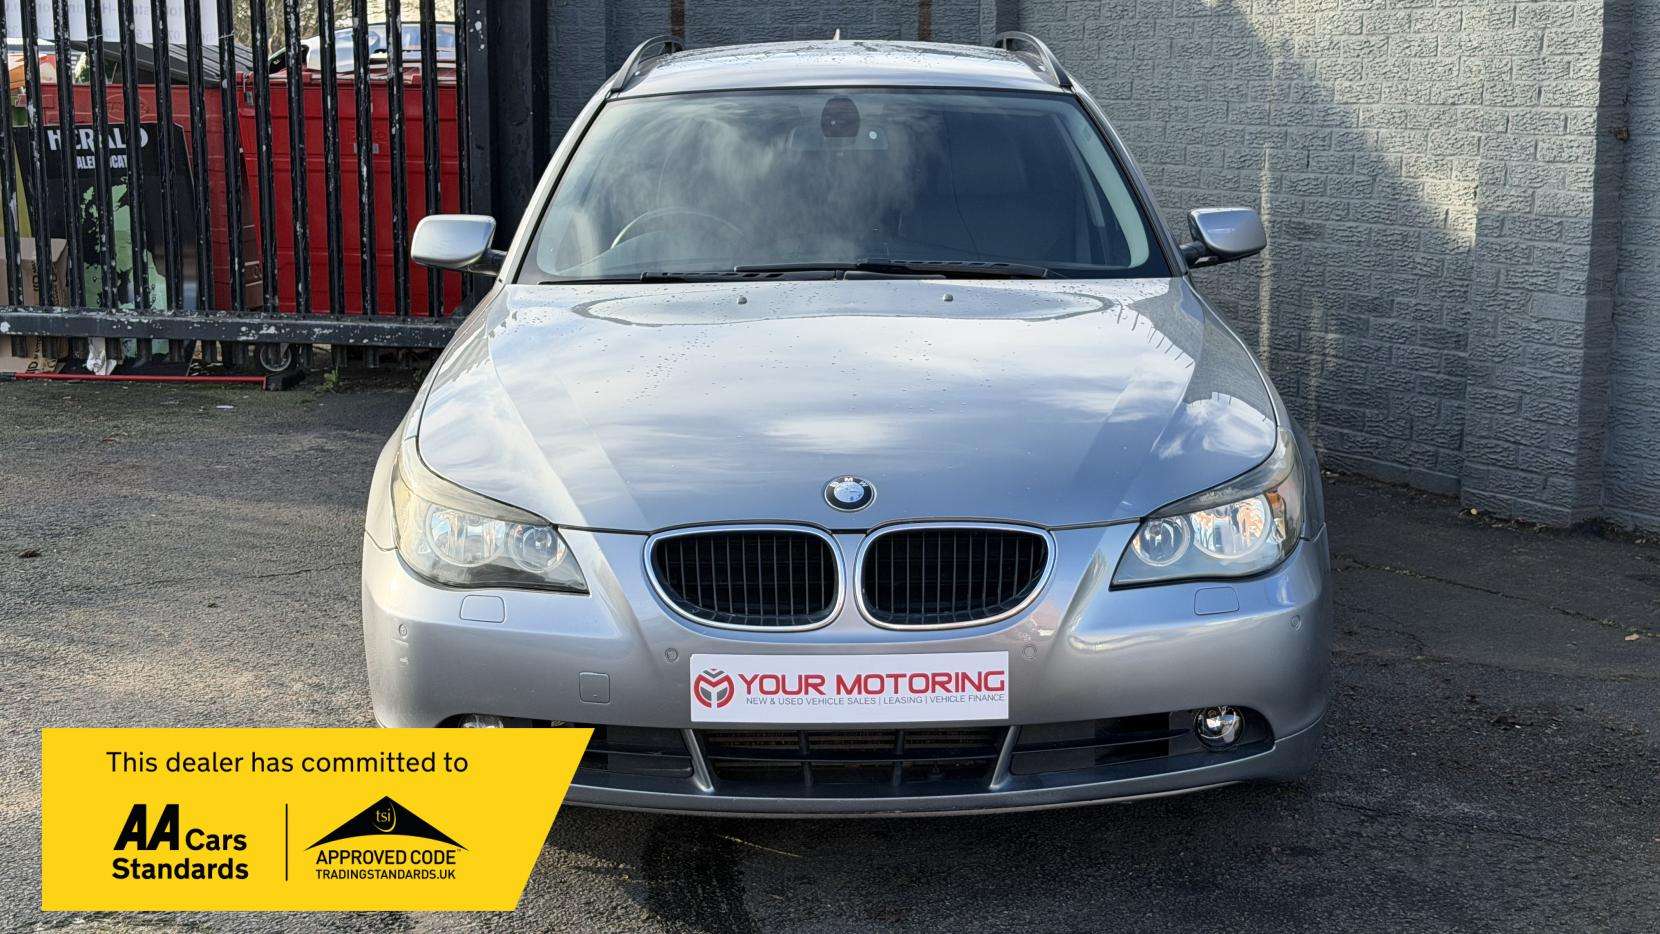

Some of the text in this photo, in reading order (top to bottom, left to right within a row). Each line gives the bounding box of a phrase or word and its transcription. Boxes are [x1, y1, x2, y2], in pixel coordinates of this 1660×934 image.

[738, 670, 1005, 696] YOUR MOTORING
[746, 693, 1005, 706] NEW & USED VEHICLE SALES LEASING VEHICLE FINANCE
